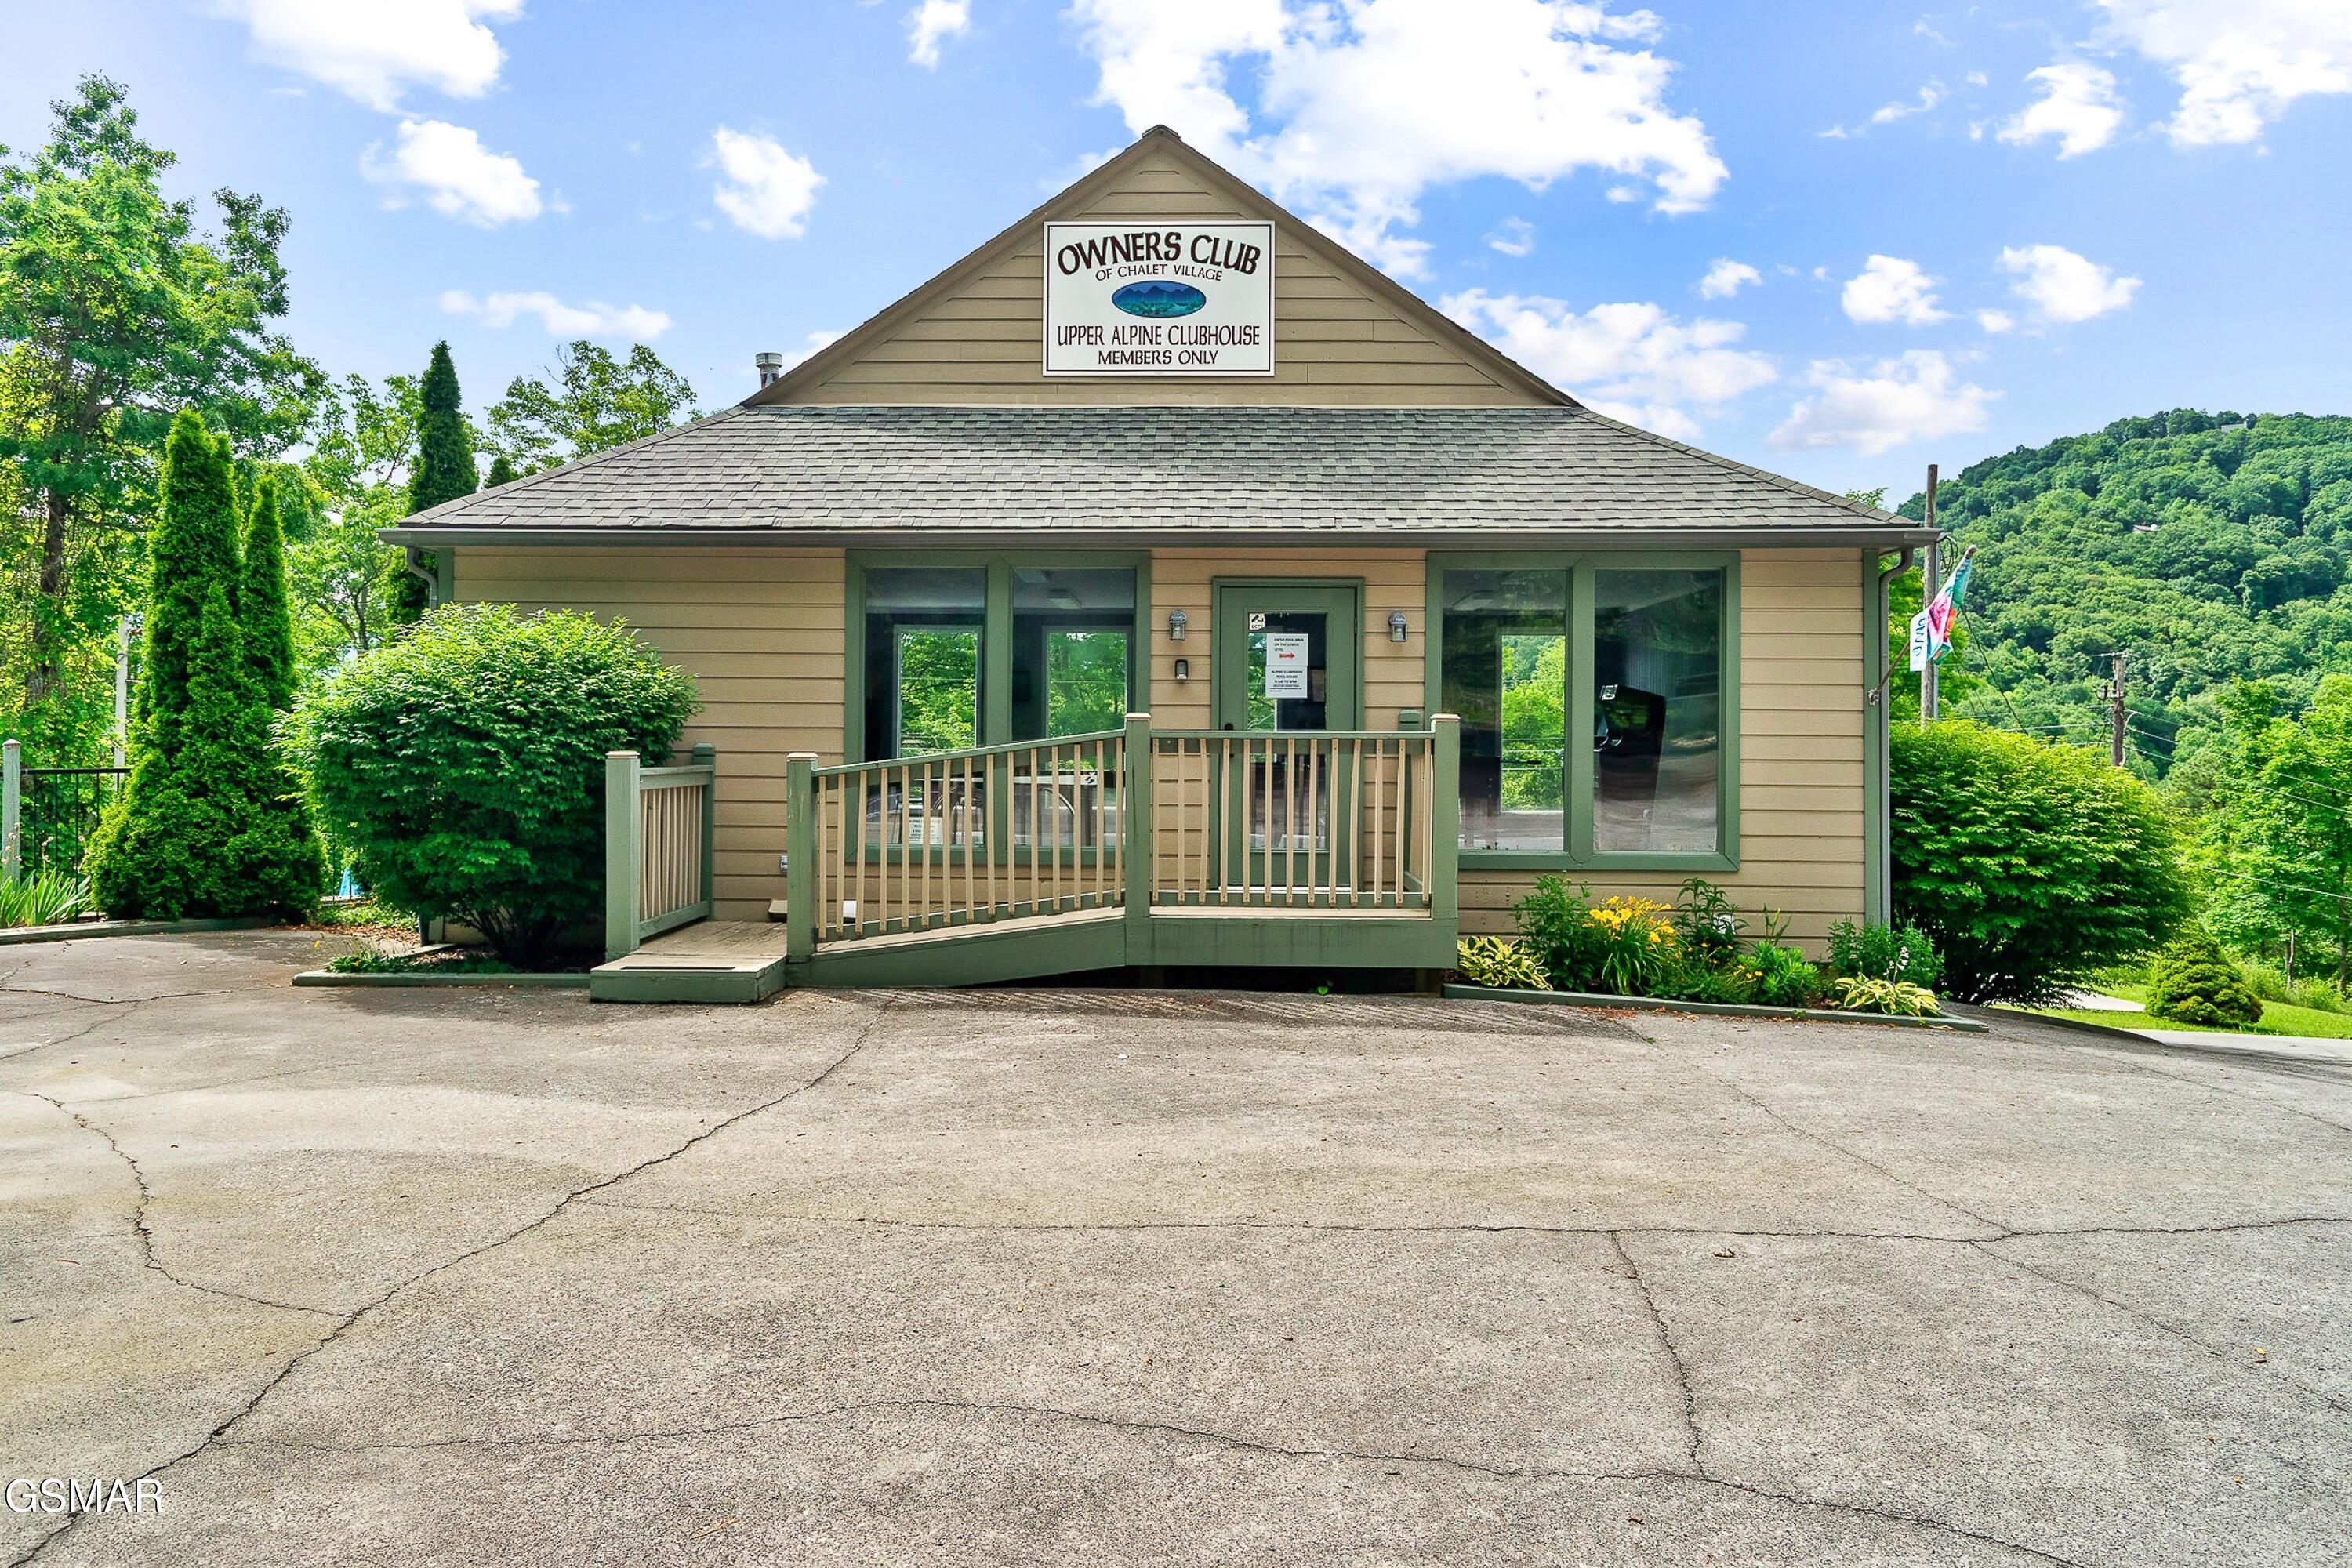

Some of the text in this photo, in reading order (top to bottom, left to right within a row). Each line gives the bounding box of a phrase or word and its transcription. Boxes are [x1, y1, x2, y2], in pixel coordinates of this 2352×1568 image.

[1058, 231, 1261, 275] OWNERS CLUB
[1095, 263, 1223, 281] OF CHALET VILLAGE
[1057, 325, 1261, 346] UPPER ALPINE CLUBHOUSE
[1098, 350, 1219, 365] MEMBERS ONLY
